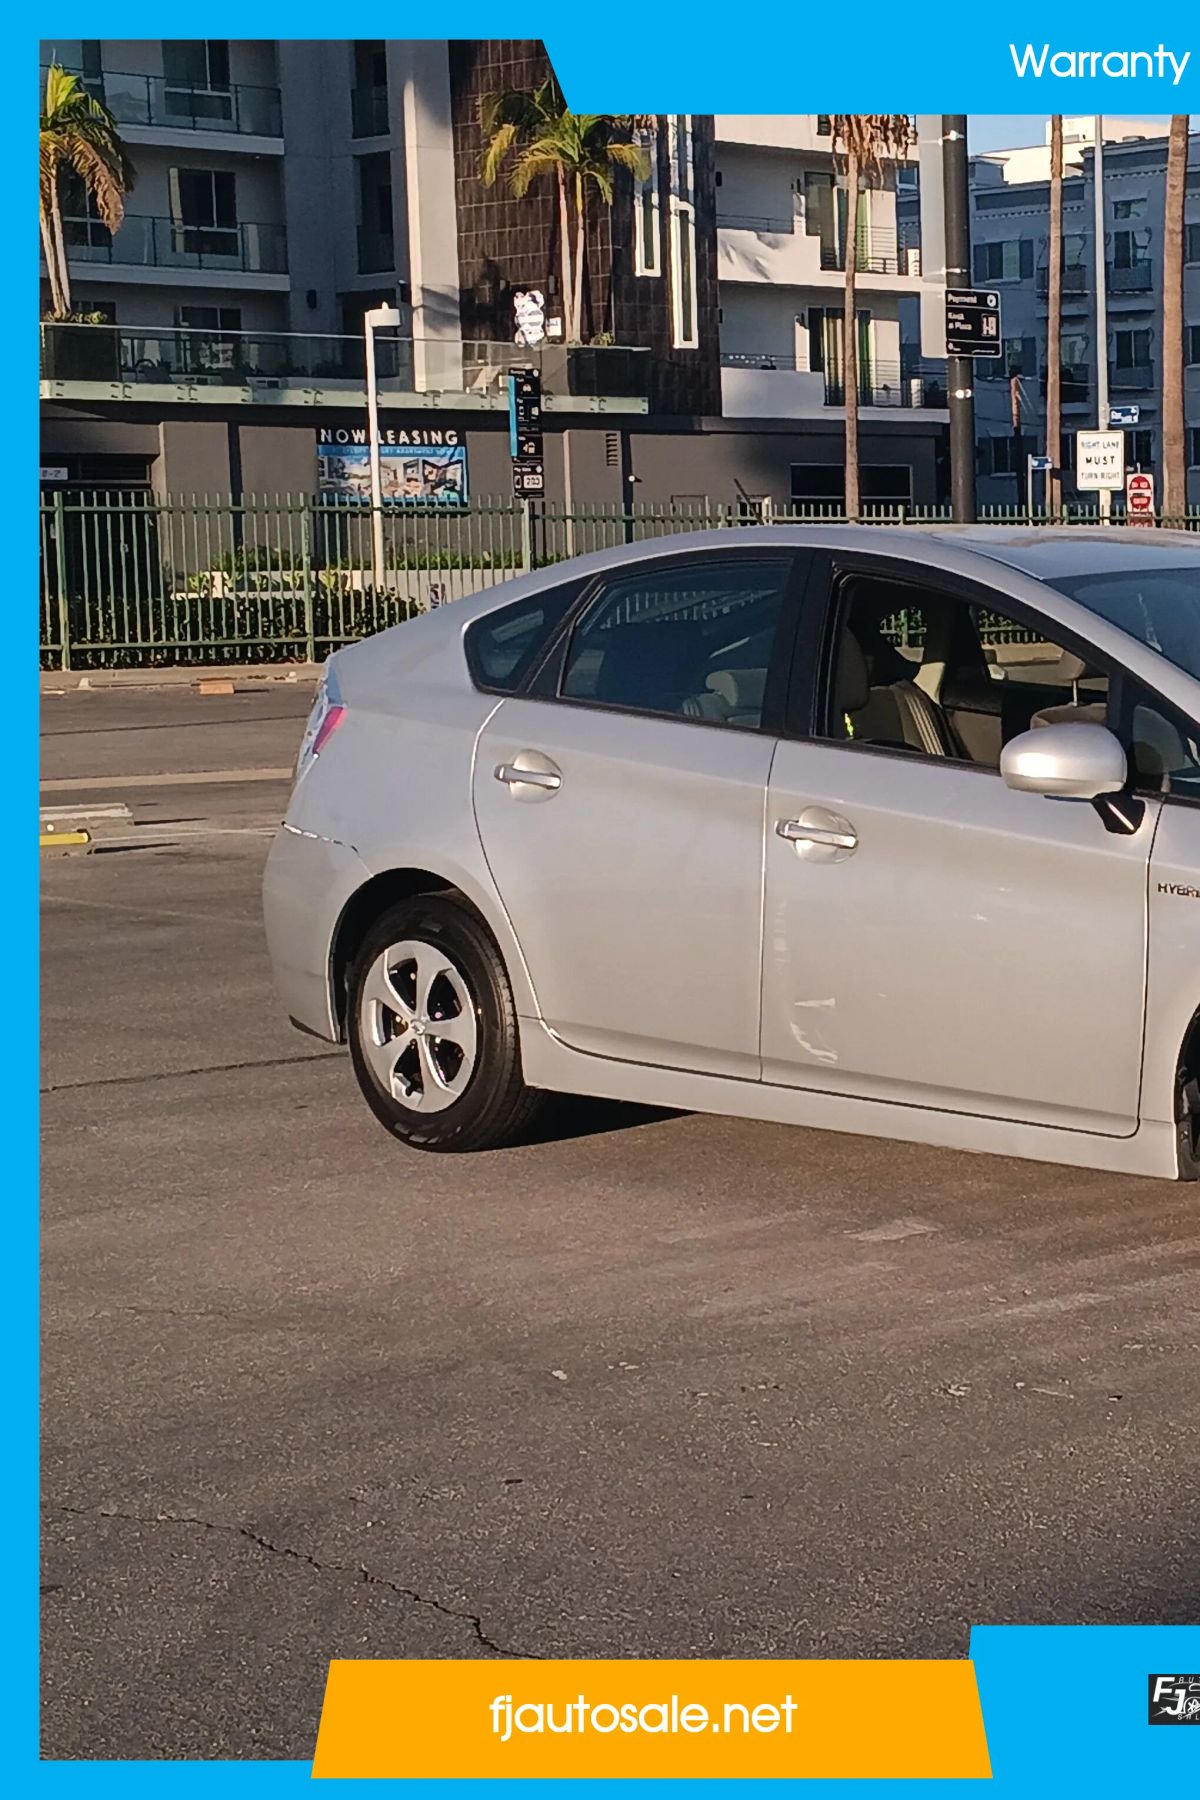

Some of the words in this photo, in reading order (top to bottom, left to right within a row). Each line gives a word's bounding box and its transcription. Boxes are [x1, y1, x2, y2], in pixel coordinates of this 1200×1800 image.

[320, 428, 366, 444] NOW
[377, 429, 458, 445] LEASING
[1102, 441, 1120, 449] LANE
[1085, 455, 1116, 465] MUST
[1081, 471, 1099, 480] TURN
